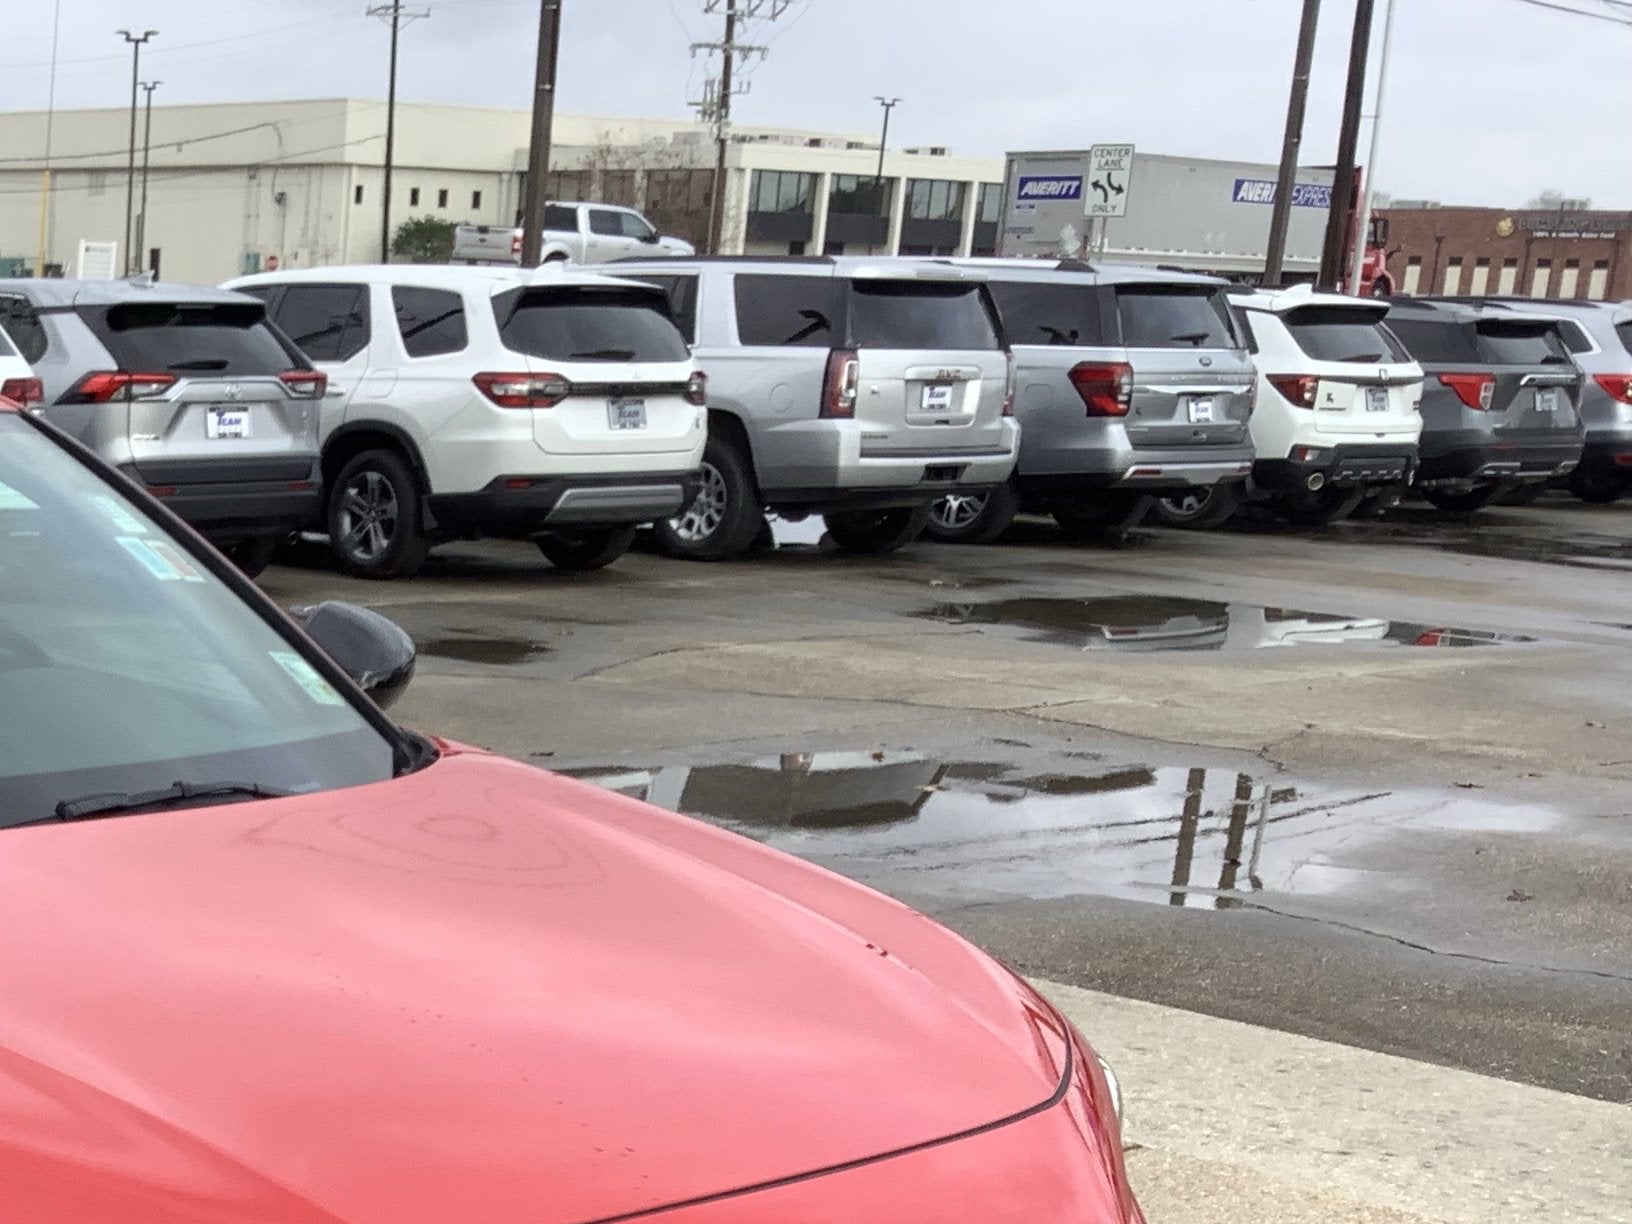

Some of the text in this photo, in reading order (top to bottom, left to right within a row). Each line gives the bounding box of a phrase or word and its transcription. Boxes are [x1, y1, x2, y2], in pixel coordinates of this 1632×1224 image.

[1094, 147, 1130, 158] CENTER
[1098, 158, 1121, 169] LANE
[1020, 180, 1081, 197] AVERITT
[1236, 180, 1332, 206] AVERI EXPRES
[1091, 203, 1118, 213] ONLY
